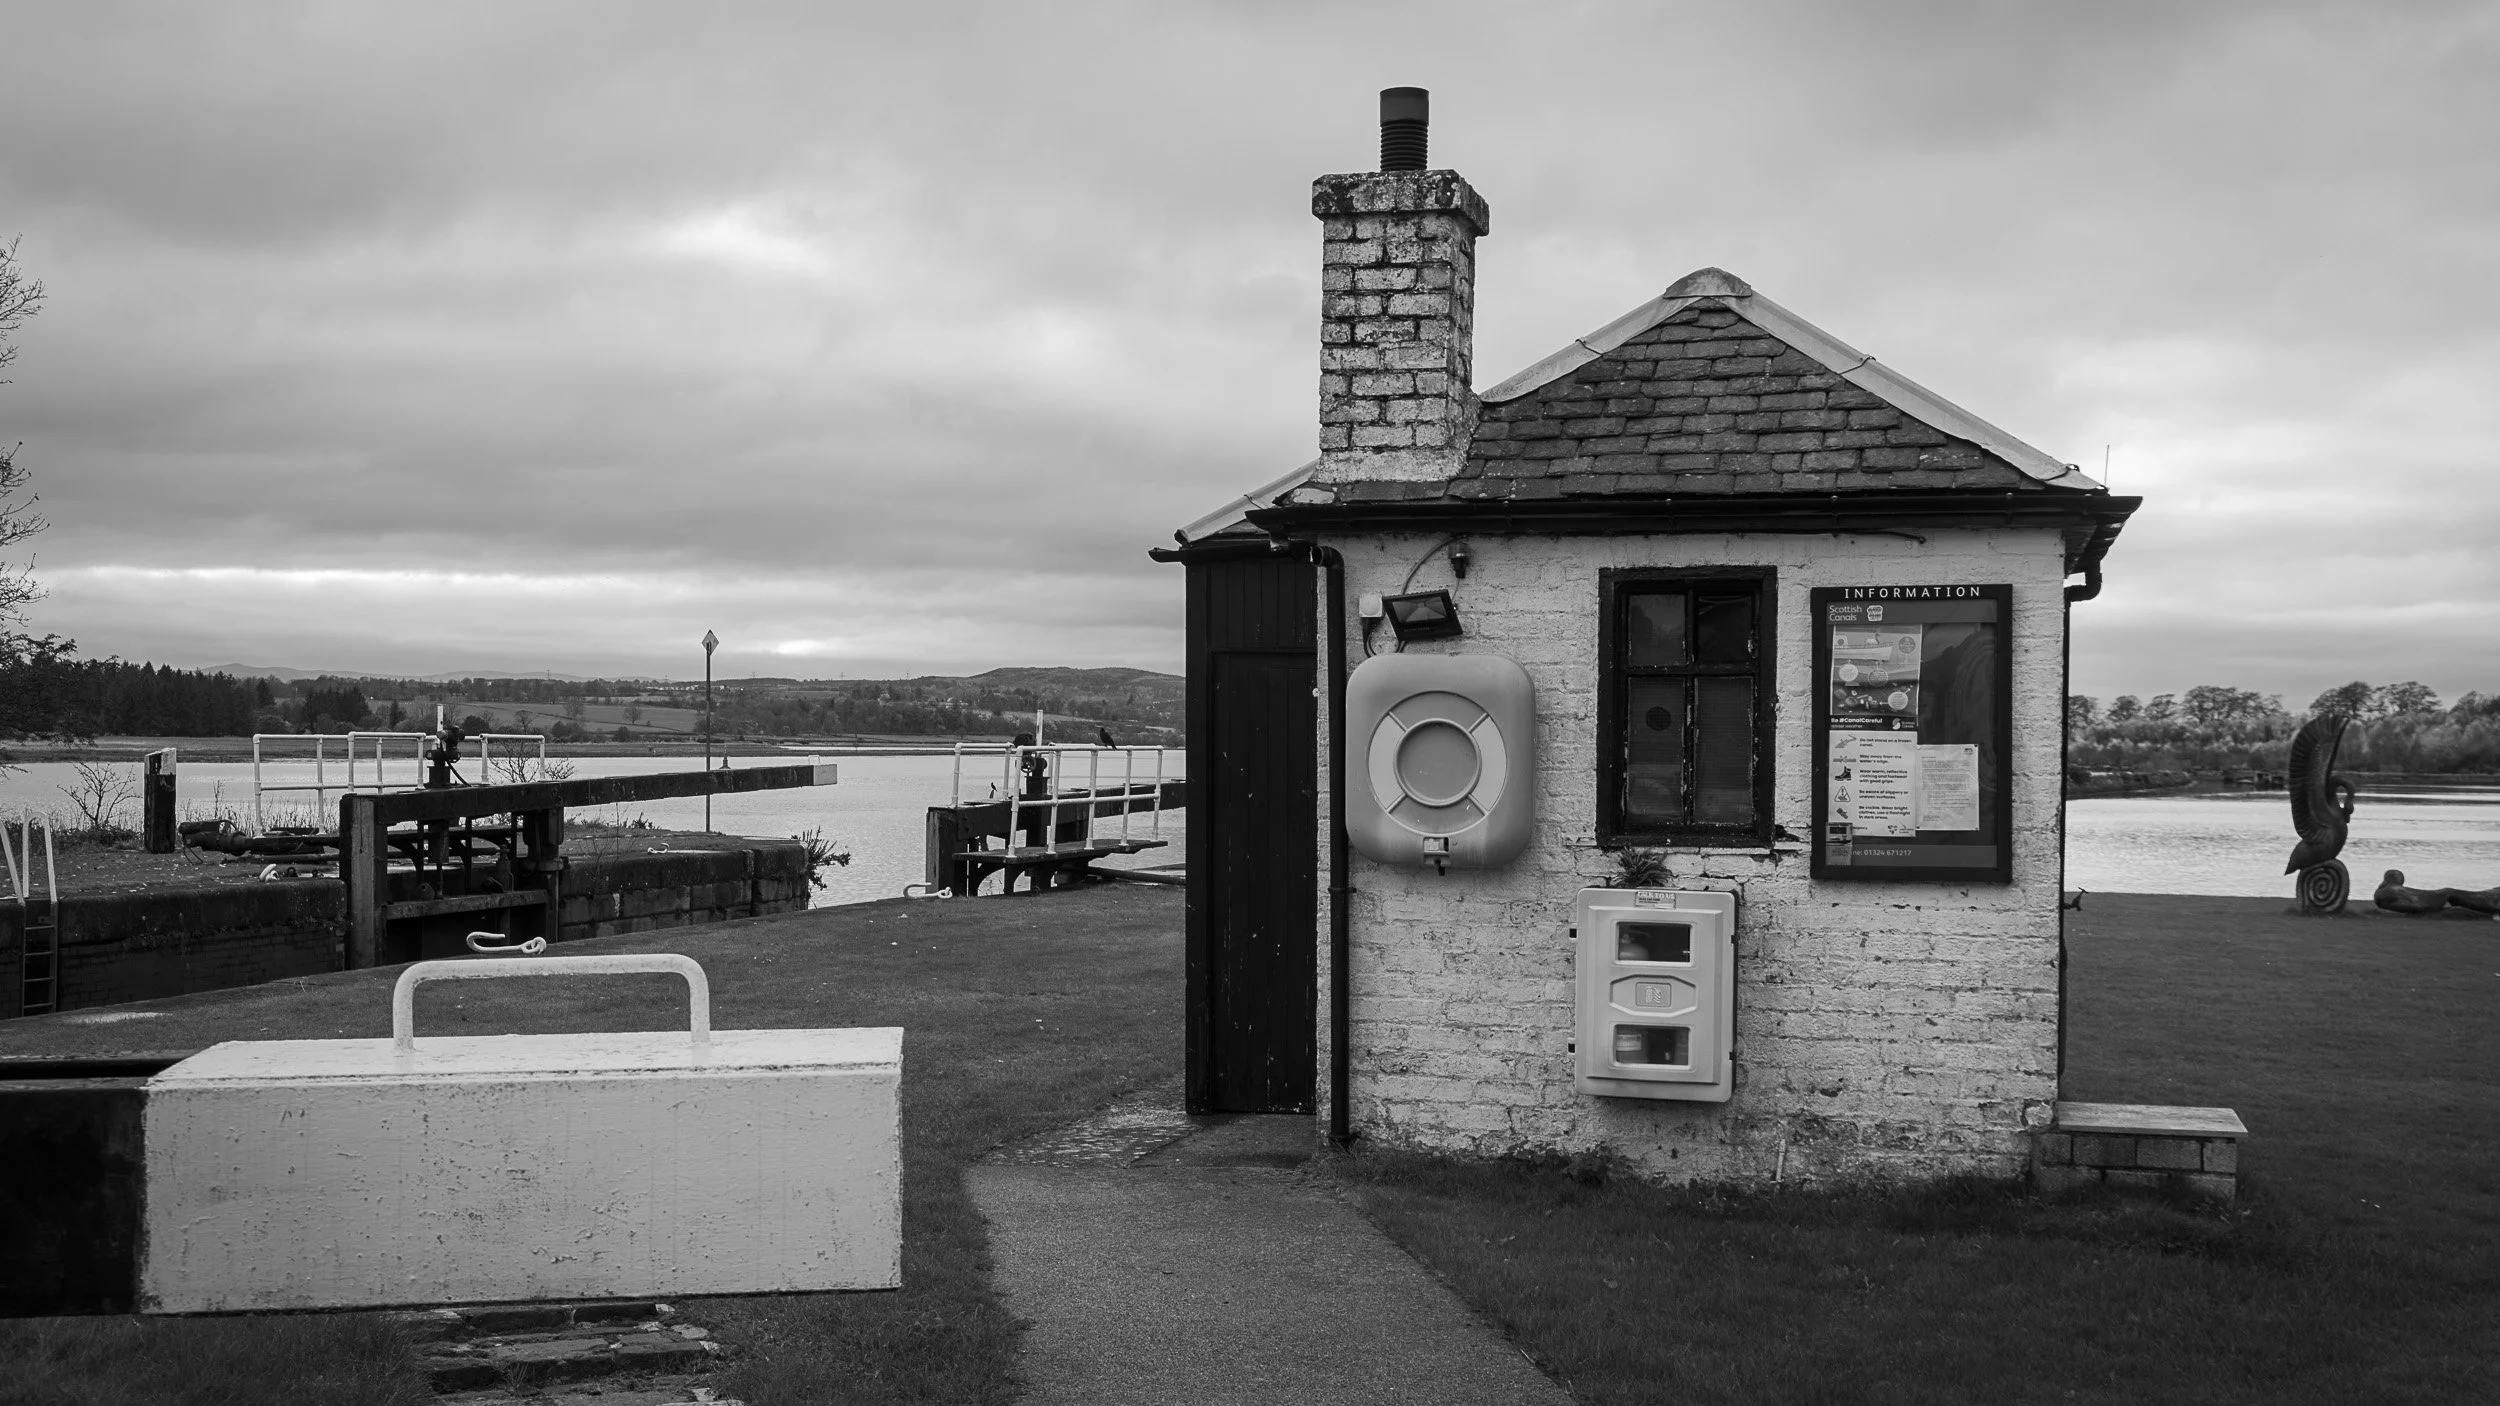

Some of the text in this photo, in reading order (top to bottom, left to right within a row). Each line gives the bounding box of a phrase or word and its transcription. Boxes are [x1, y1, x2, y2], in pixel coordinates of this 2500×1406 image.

[1844, 586, 1980, 599] INFORMATION
[1829, 605, 1862, 613] Scottish
[1829, 613, 1857, 621] Canals
